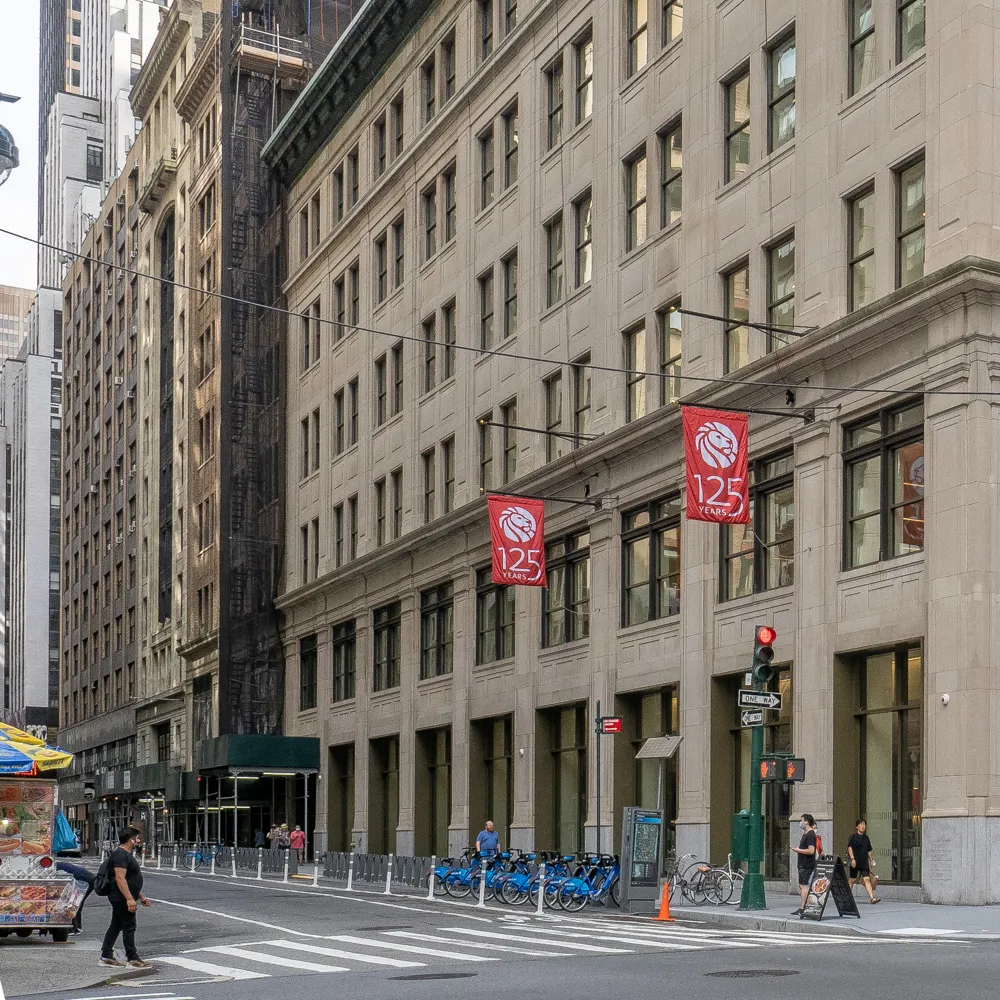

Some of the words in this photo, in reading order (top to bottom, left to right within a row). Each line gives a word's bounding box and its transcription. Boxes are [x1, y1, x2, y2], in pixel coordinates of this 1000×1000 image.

[693, 473, 744, 517] 125
[698, 505, 727, 516] YEARS
[498, 547, 541, 580] 125
[503, 571, 527, 580] YEARS
[745, 695, 758, 703] ONE
